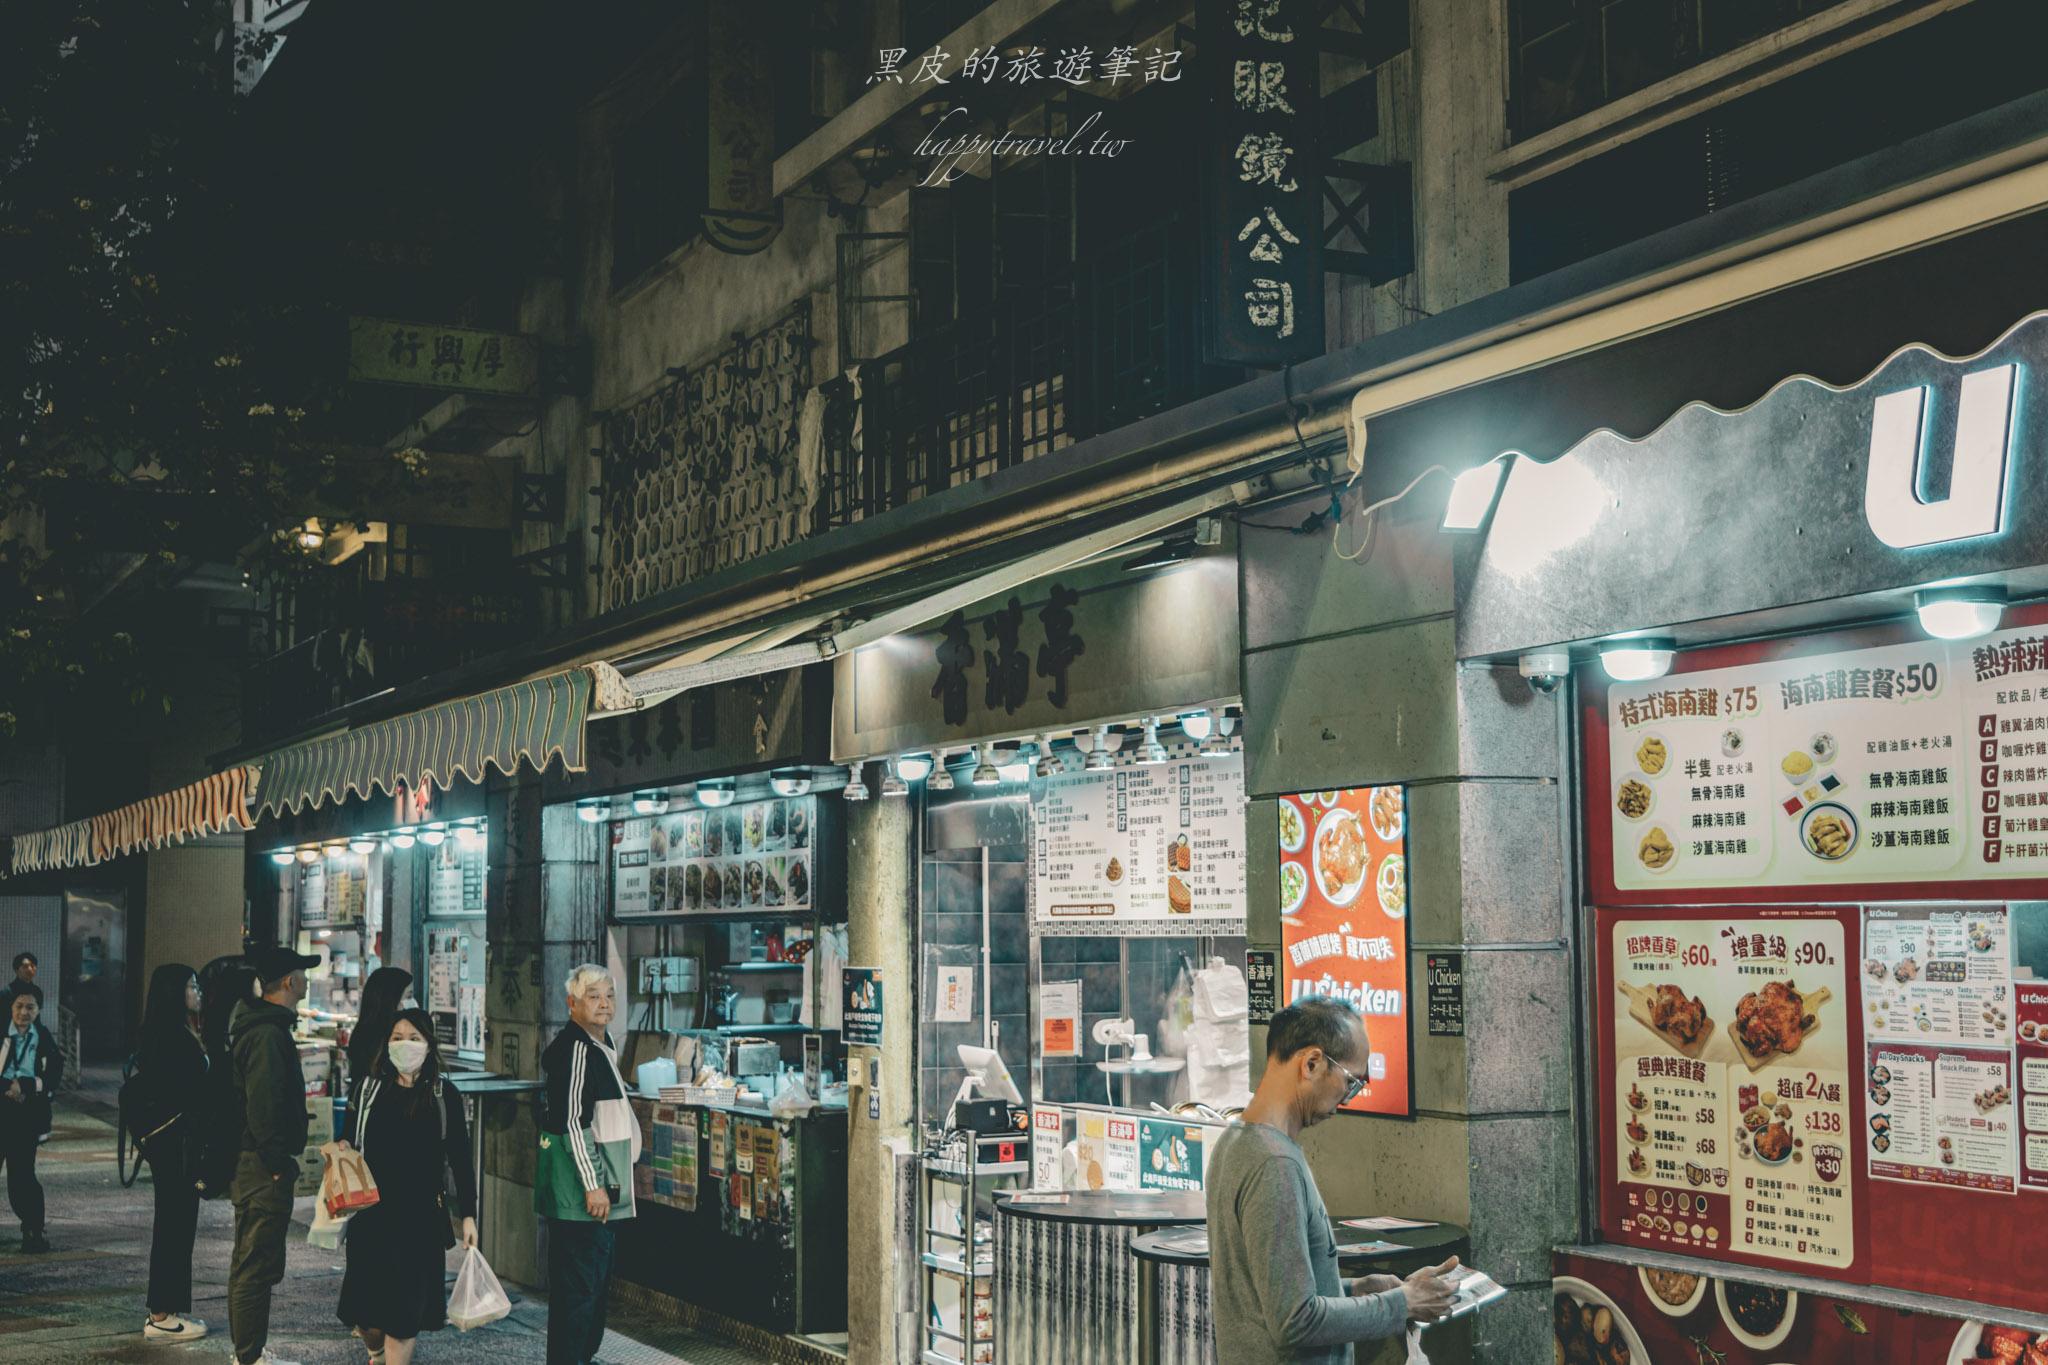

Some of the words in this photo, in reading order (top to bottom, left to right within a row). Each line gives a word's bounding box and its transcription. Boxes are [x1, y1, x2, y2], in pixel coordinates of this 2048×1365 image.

[1780, 668, 1895, 709] 海南雞套餐
[1896, 662, 1937, 696] $50
[1618, 688, 1718, 728] 特式海南雞
[1725, 685, 1758, 715] $75
[2000, 717, 2048, 734] 雞翼滷肉
[1684, 759, 1711, 779] 半隻
[1869, 767, 1948, 789] 無骨海南雞飯
[1691, 784, 1745, 801] 無骨海南雞
[1870, 798, 1949, 818] 麻辣海南雞飯
[1692, 811, 1746, 829] 麻辣海南雞
[1871, 828, 1949, 848] 沙薑海南雞飯
[1626, 935, 1677, 956] 招牌香草
[1730, 934, 1787, 959] 增量級
[1900, 943, 1916, 954] $90
[1428, 968, 1435, 986] U
[1435, 968, 1461, 986] Chicken
[1637, 1056, 1706, 1084] 經典烤雞餐
[1695, 1107, 1715, 1124] $58
[1805, 1111, 1841, 1132] $138
[1696, 1138, 1715, 1154] $68
